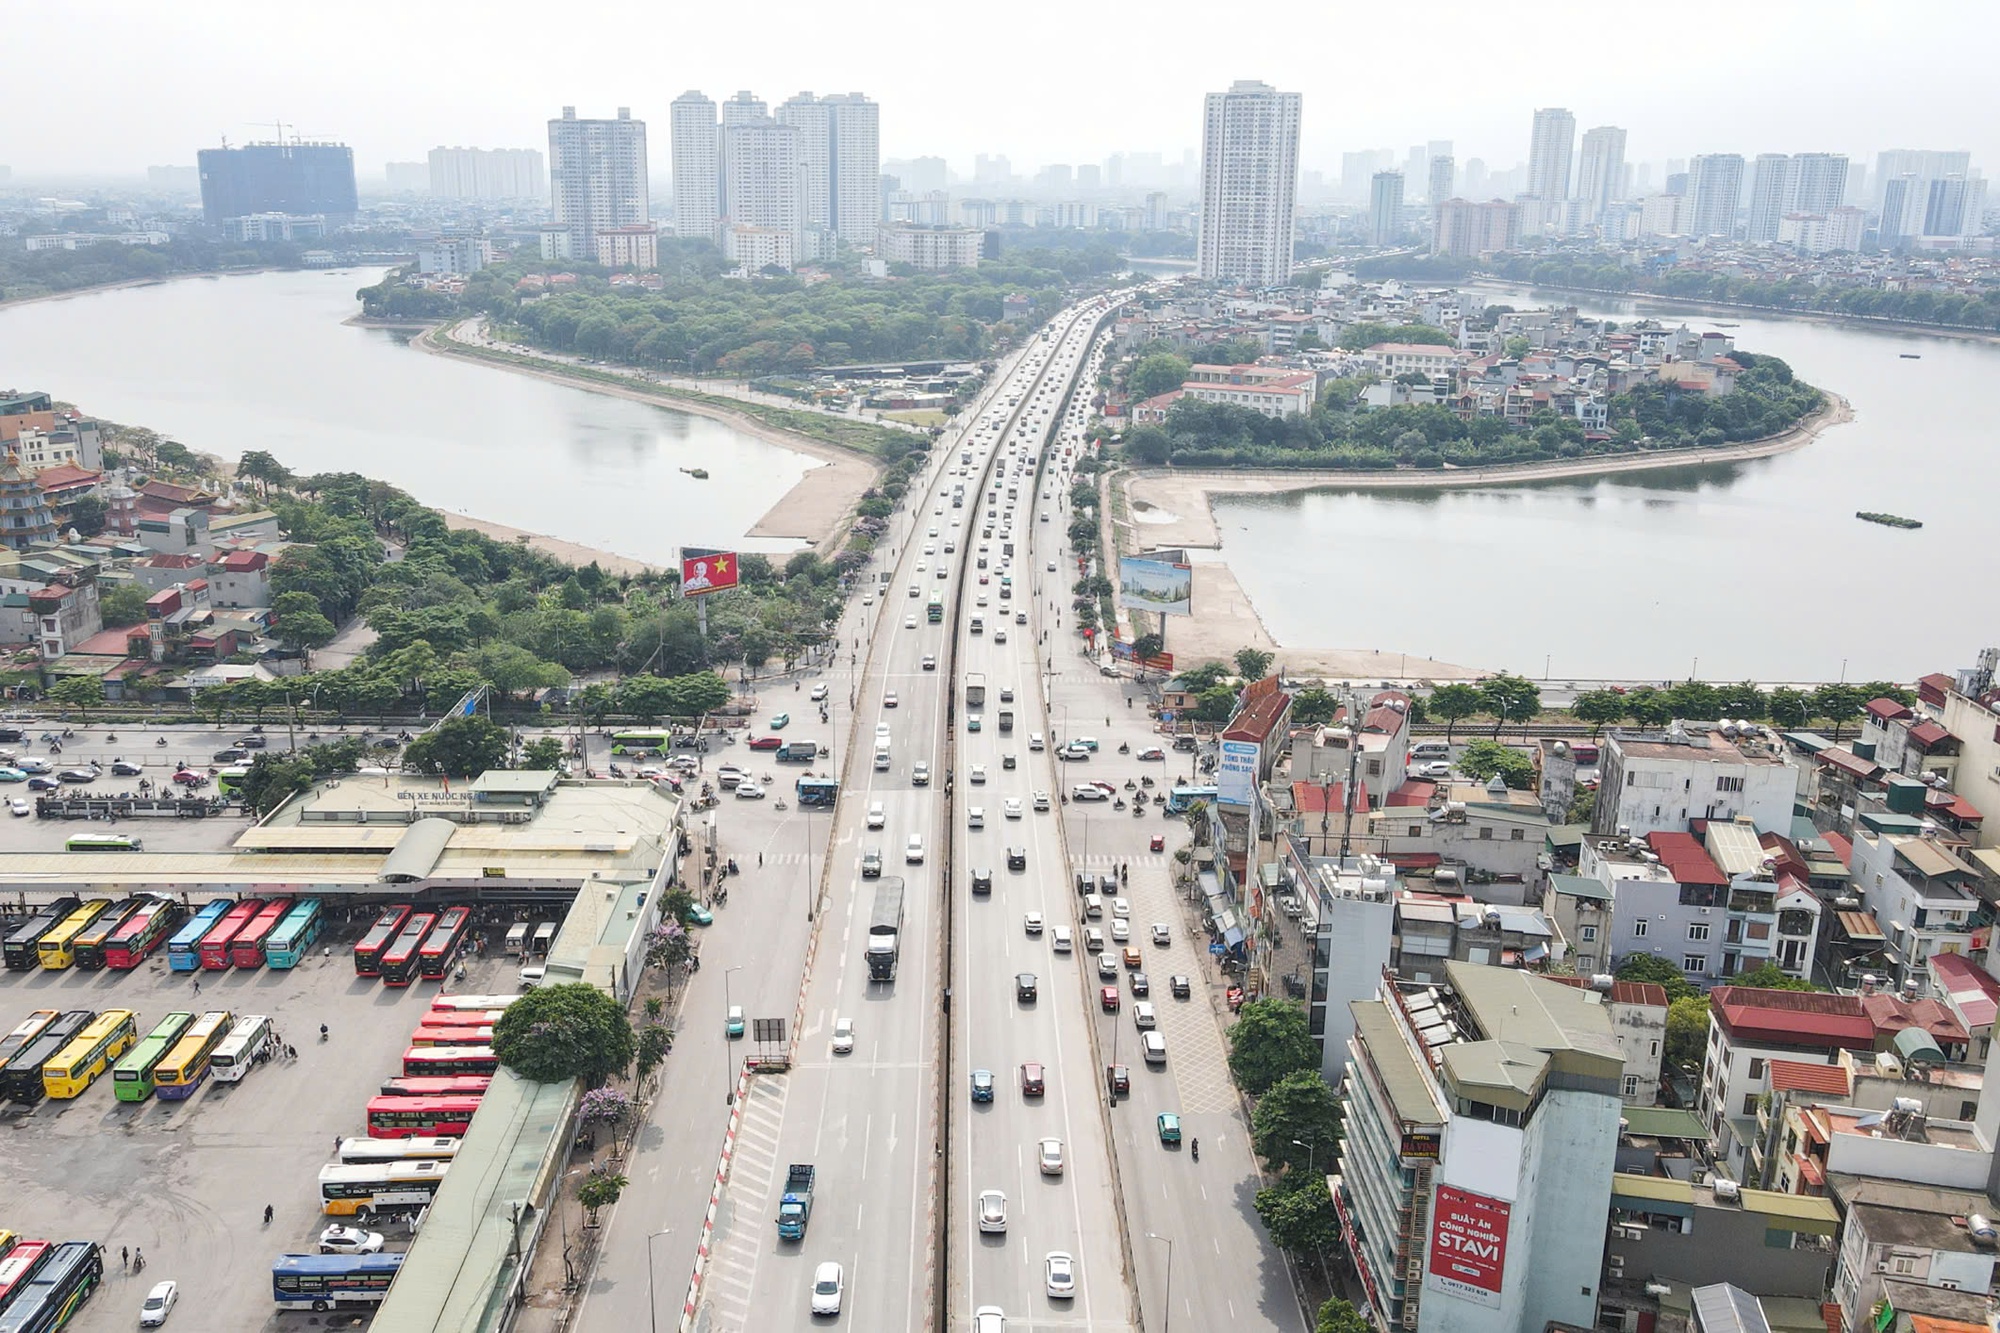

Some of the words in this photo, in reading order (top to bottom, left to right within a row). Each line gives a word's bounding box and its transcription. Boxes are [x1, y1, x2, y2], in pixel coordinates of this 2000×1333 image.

[417, 792, 429, 800] XE
[1439, 1220, 1465, 1233] CÔNG
[1467, 1228, 1500, 1243] NGHIỆP
[1438, 1231, 1499, 1262] STAVI
